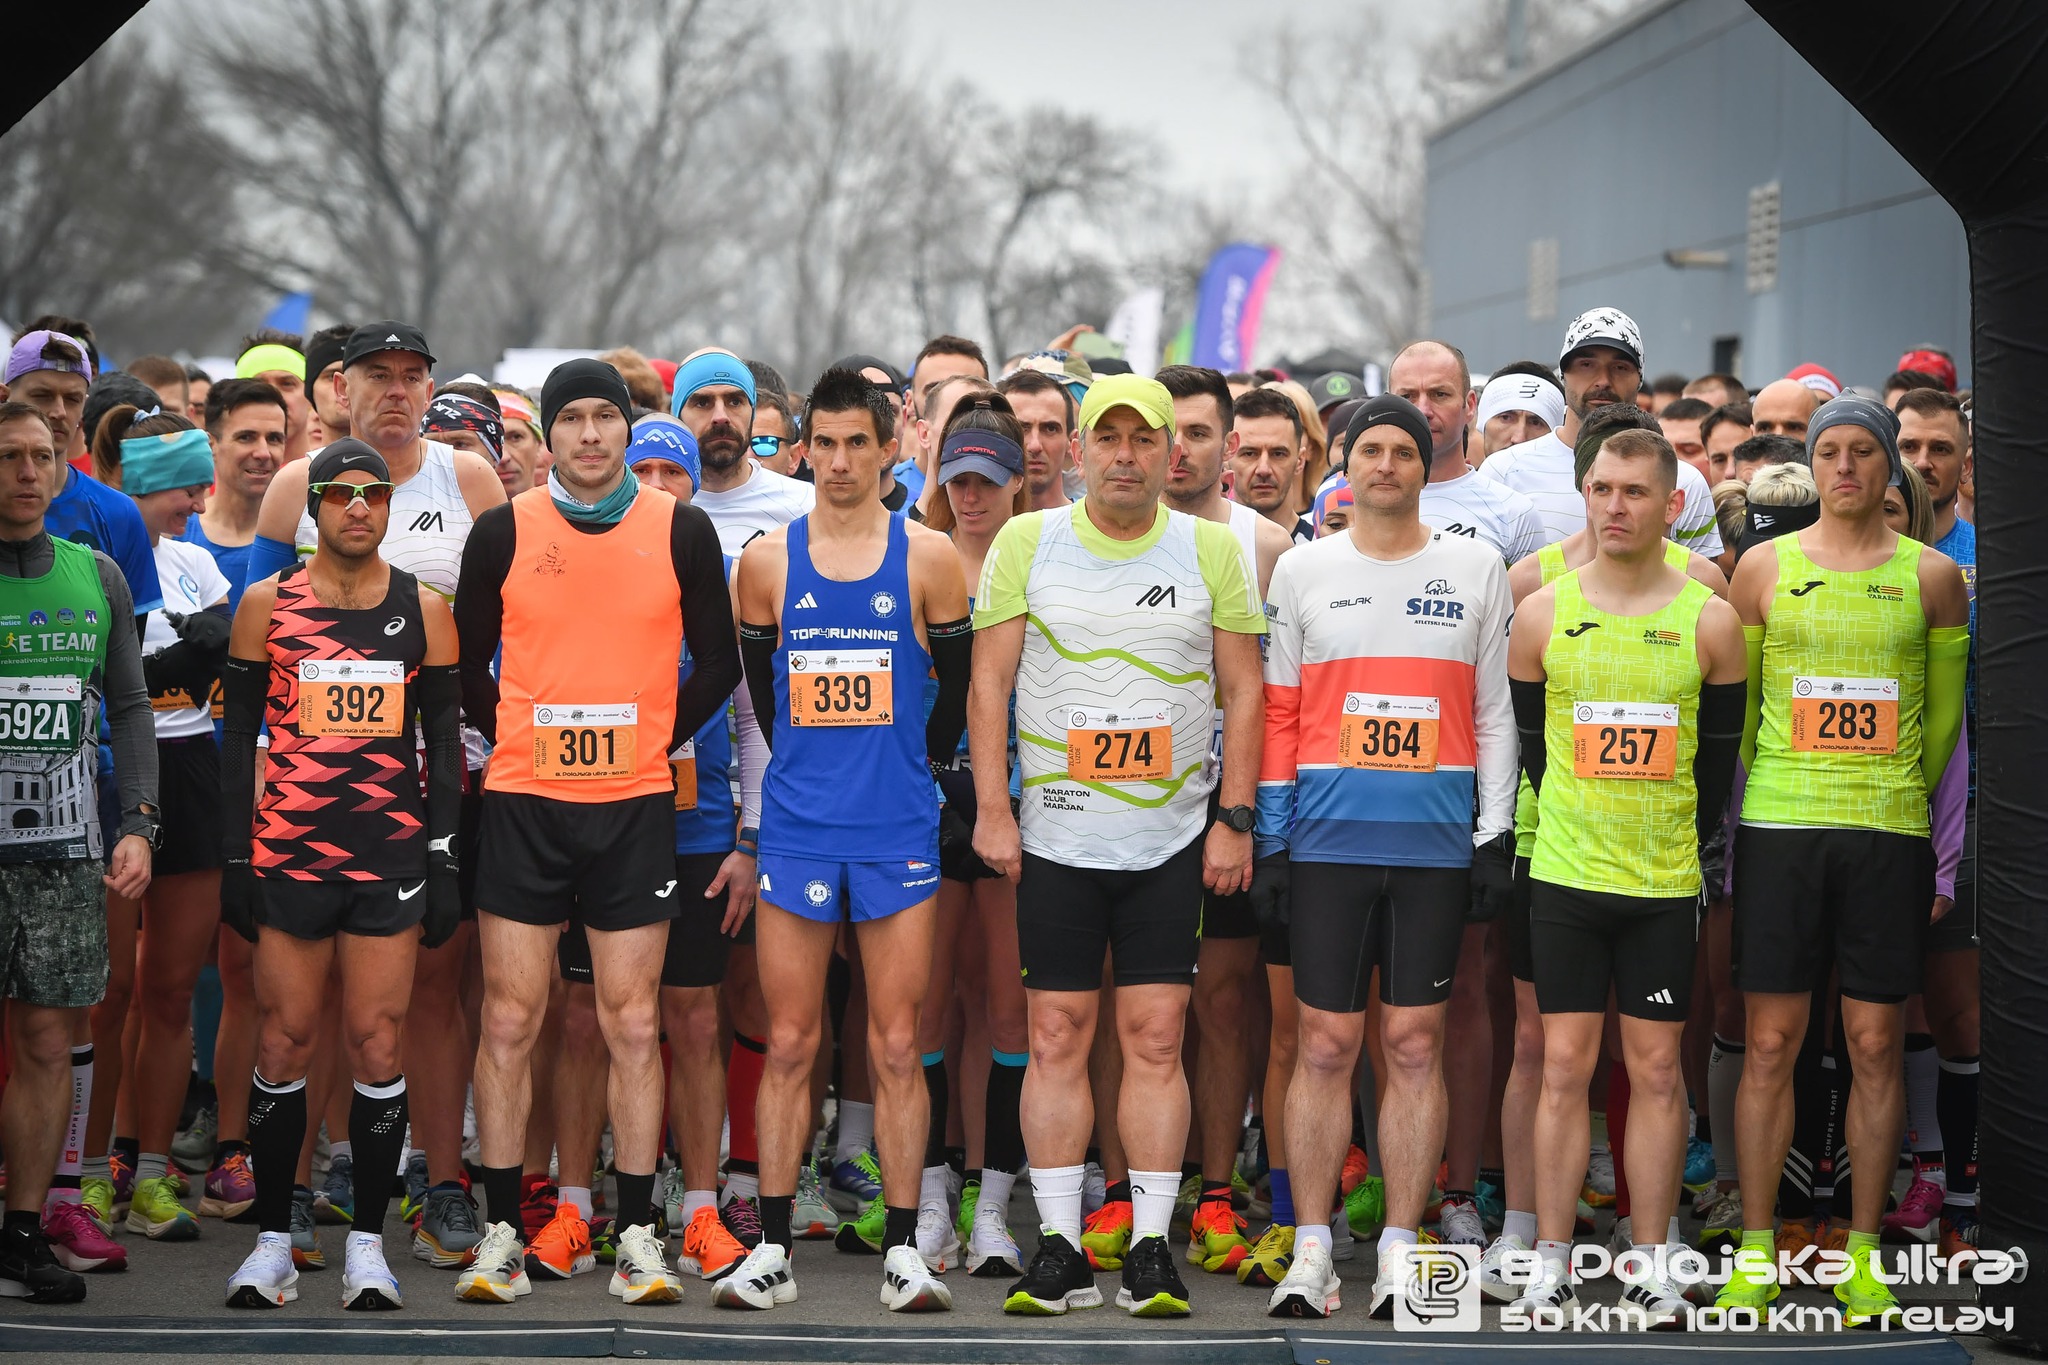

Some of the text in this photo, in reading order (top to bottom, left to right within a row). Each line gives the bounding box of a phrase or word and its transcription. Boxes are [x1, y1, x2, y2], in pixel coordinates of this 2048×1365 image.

[1867, 593, 1903, 602] VARAŽDIN
[1414, 619, 1441, 627] ATLETSKI
[38, 632, 97, 652] TEAM
[789, 627, 898, 642] TOP4RUNNING
[1643, 638, 1680, 647] VARAŽDIN
[49, 655, 74, 663] trčanja
[814, 675, 871, 712] 339
[326, 685, 385, 723] 392
[1818, 701, 1877, 739] 283
[1363, 719, 1420, 758] 364
[1599, 727, 1658, 765] 257
[559, 729, 614, 766] 301
[1094, 731, 1153, 769] 274
[1043, 787, 1090, 797] MARATON
[1043, 795, 1066, 803] KLUB
[1043, 802, 1084, 811] MARJAN
